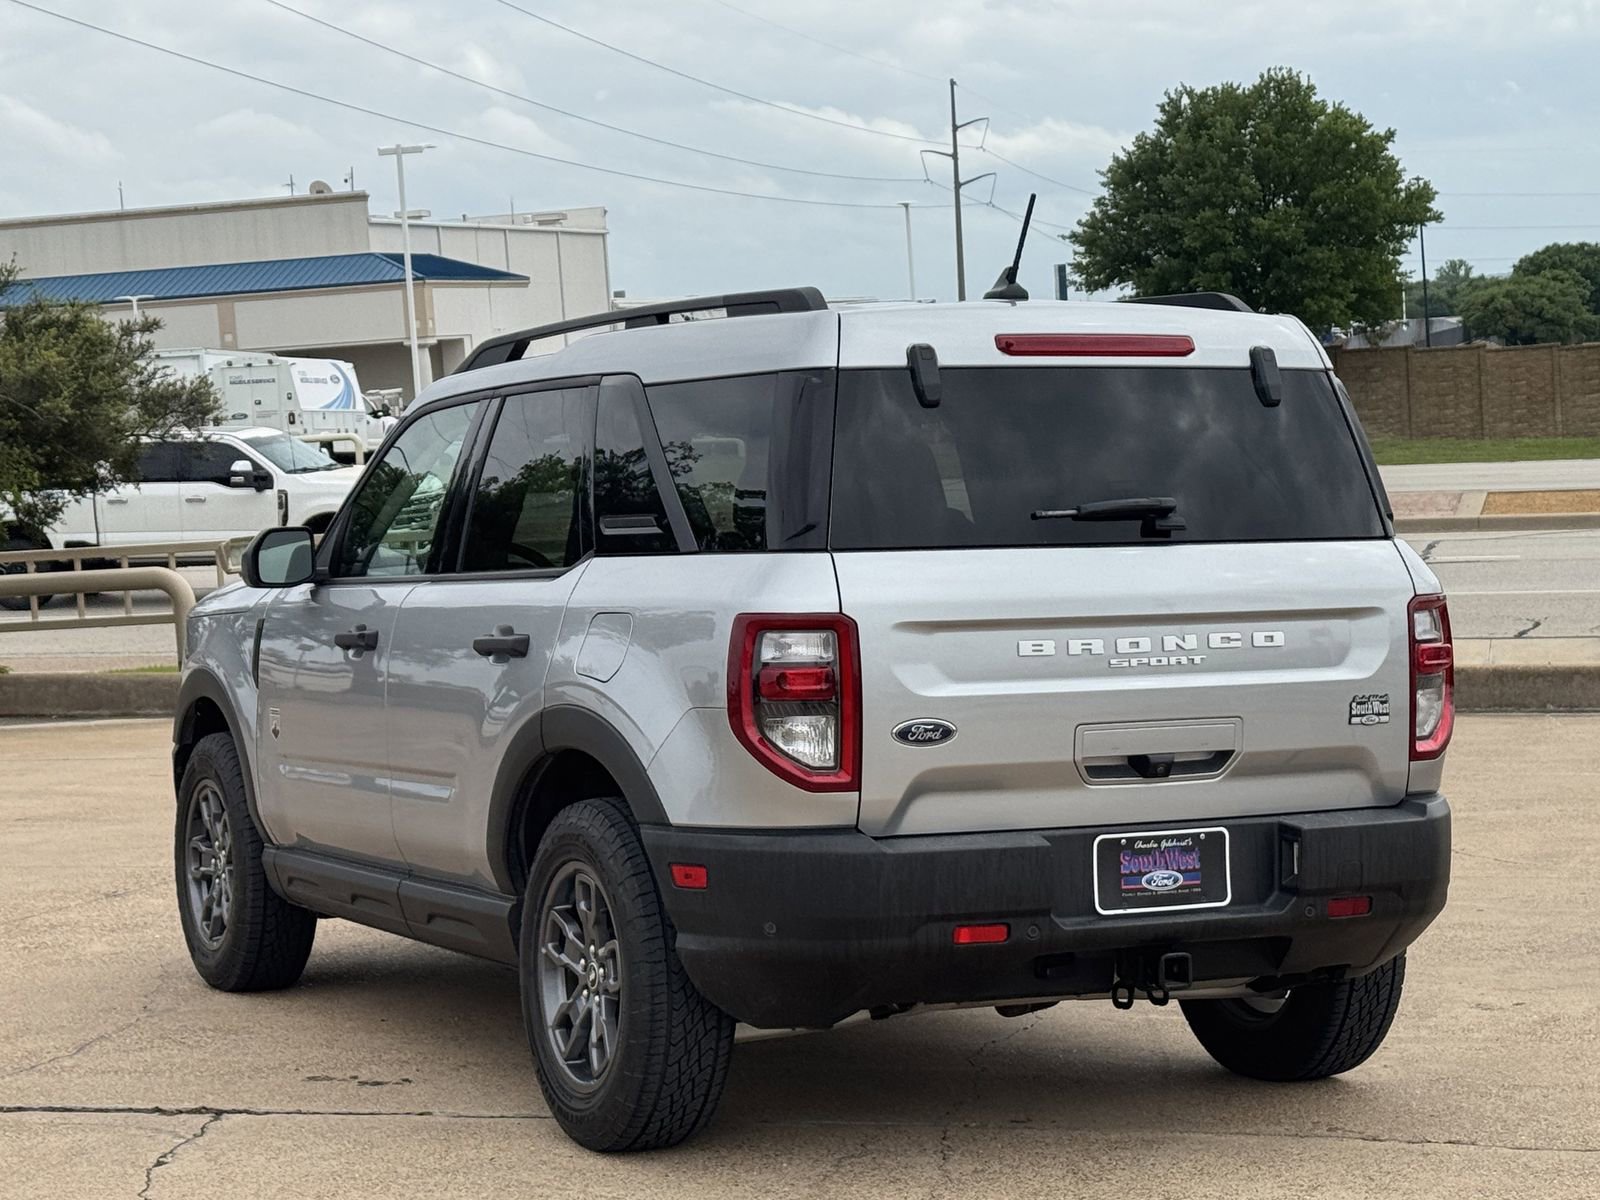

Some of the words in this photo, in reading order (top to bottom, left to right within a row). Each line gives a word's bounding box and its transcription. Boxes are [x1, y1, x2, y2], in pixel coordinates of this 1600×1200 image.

[1018, 631, 1286, 656] BRONCO
[1109, 655, 1207, 668] SPORT
[907, 724, 943, 740] Ford
[1151, 873, 1175, 887] Ford
